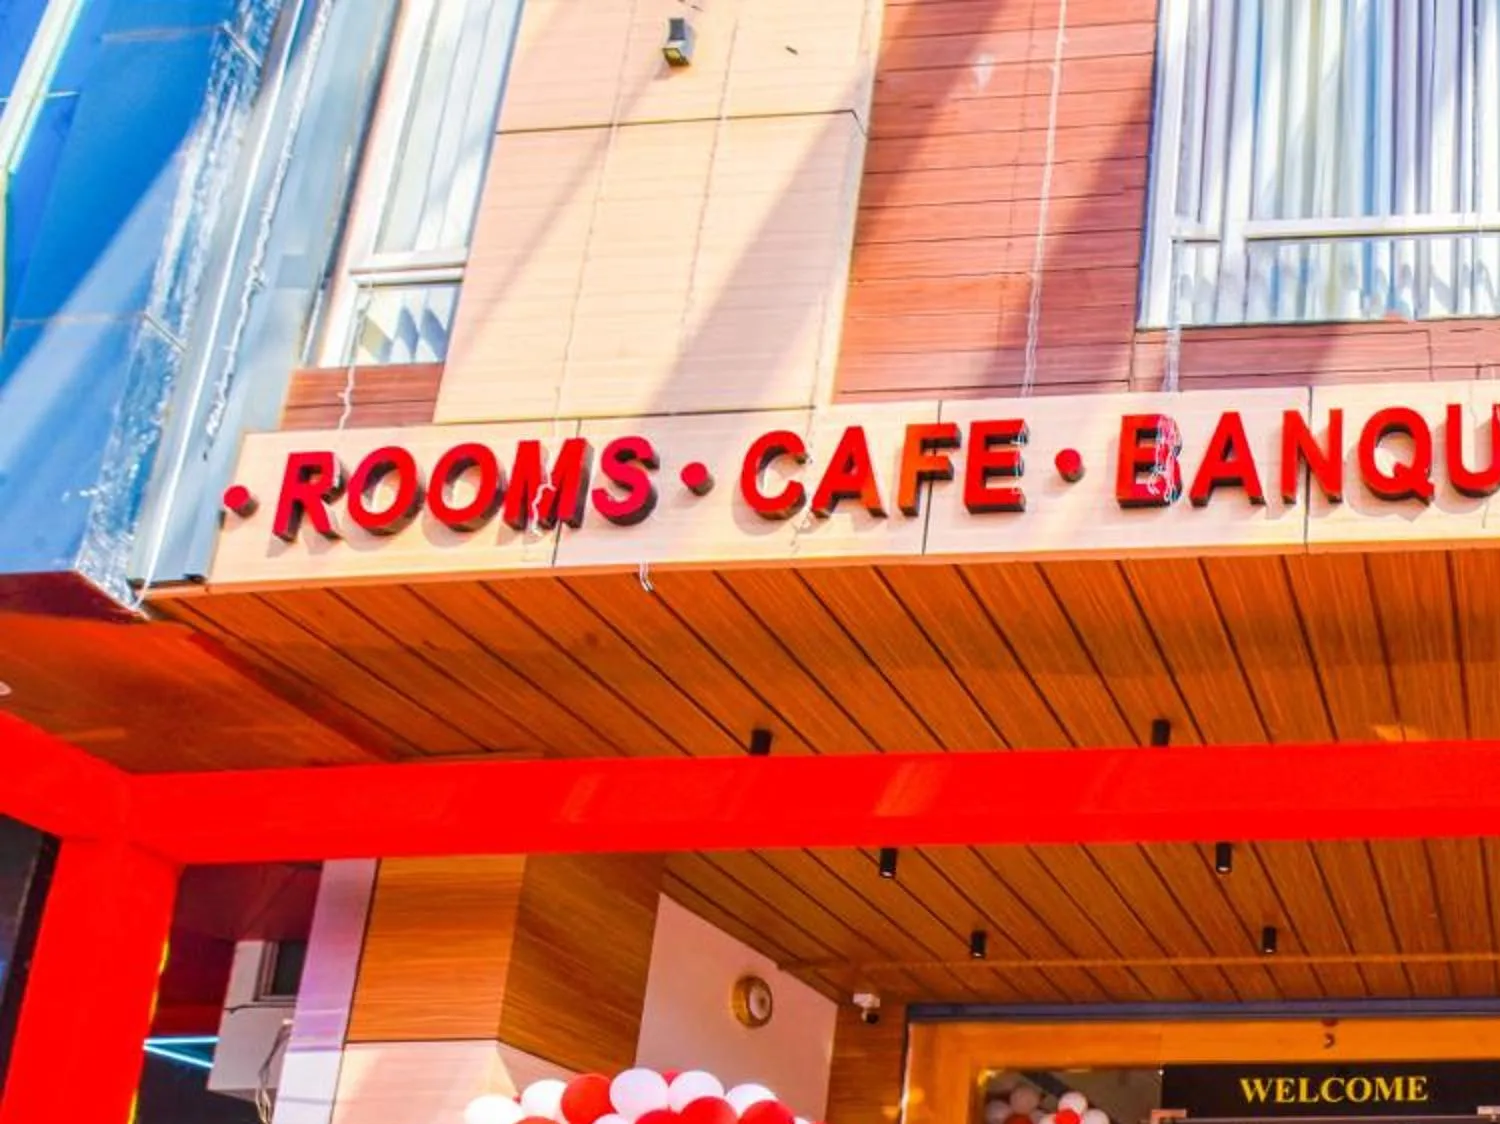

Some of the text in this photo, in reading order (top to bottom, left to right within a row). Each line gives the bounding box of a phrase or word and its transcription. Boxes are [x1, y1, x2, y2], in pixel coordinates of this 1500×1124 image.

[272, 435, 662, 542] ROOMS
[741, 418, 1029, 521] CAFE
[1239, 1075, 1428, 1103] WELCOME
